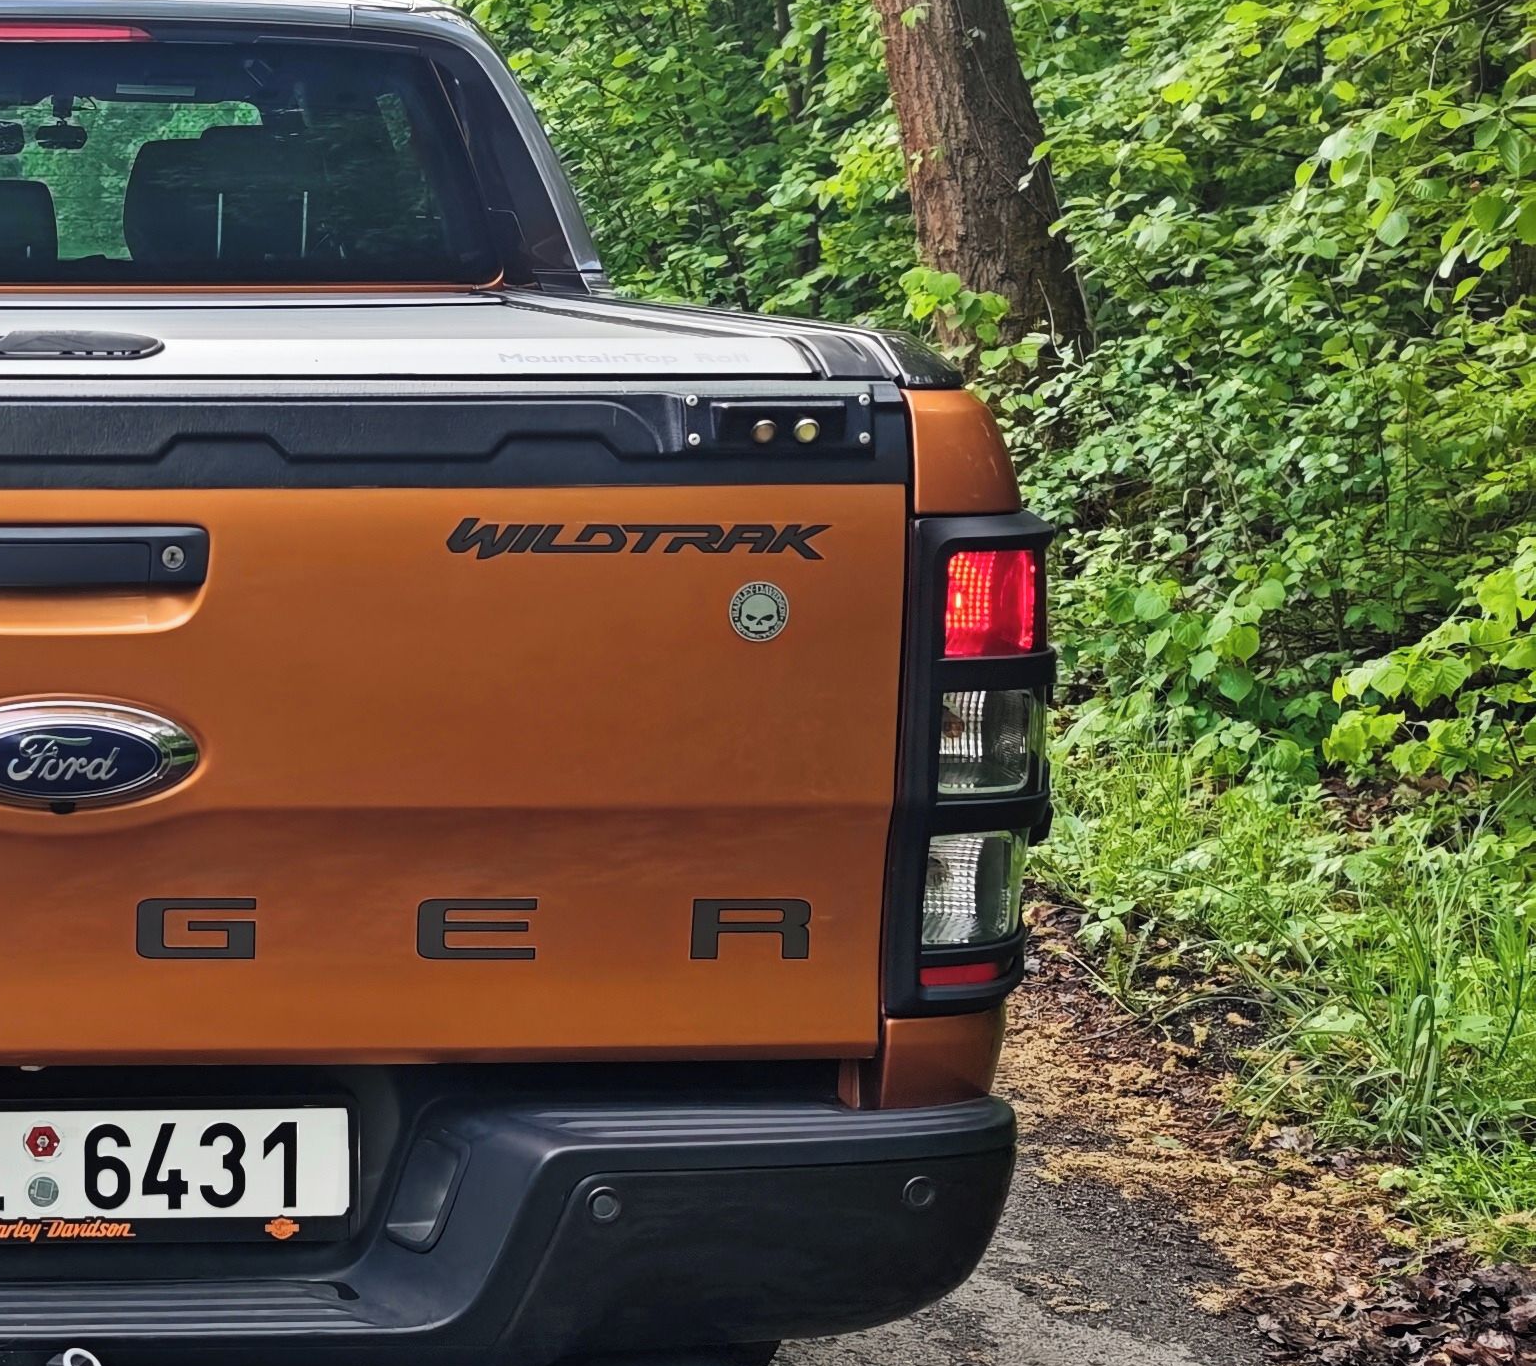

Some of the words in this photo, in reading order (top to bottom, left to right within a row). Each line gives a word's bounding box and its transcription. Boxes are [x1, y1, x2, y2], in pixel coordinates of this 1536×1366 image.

[497, 353, 678, 365] MountainTop
[694, 352, 750, 364] Roll
[446, 517, 833, 560] WILDTRAK
[7, 734, 120, 781] Ford
[84, 1121, 299, 1210] 6431
